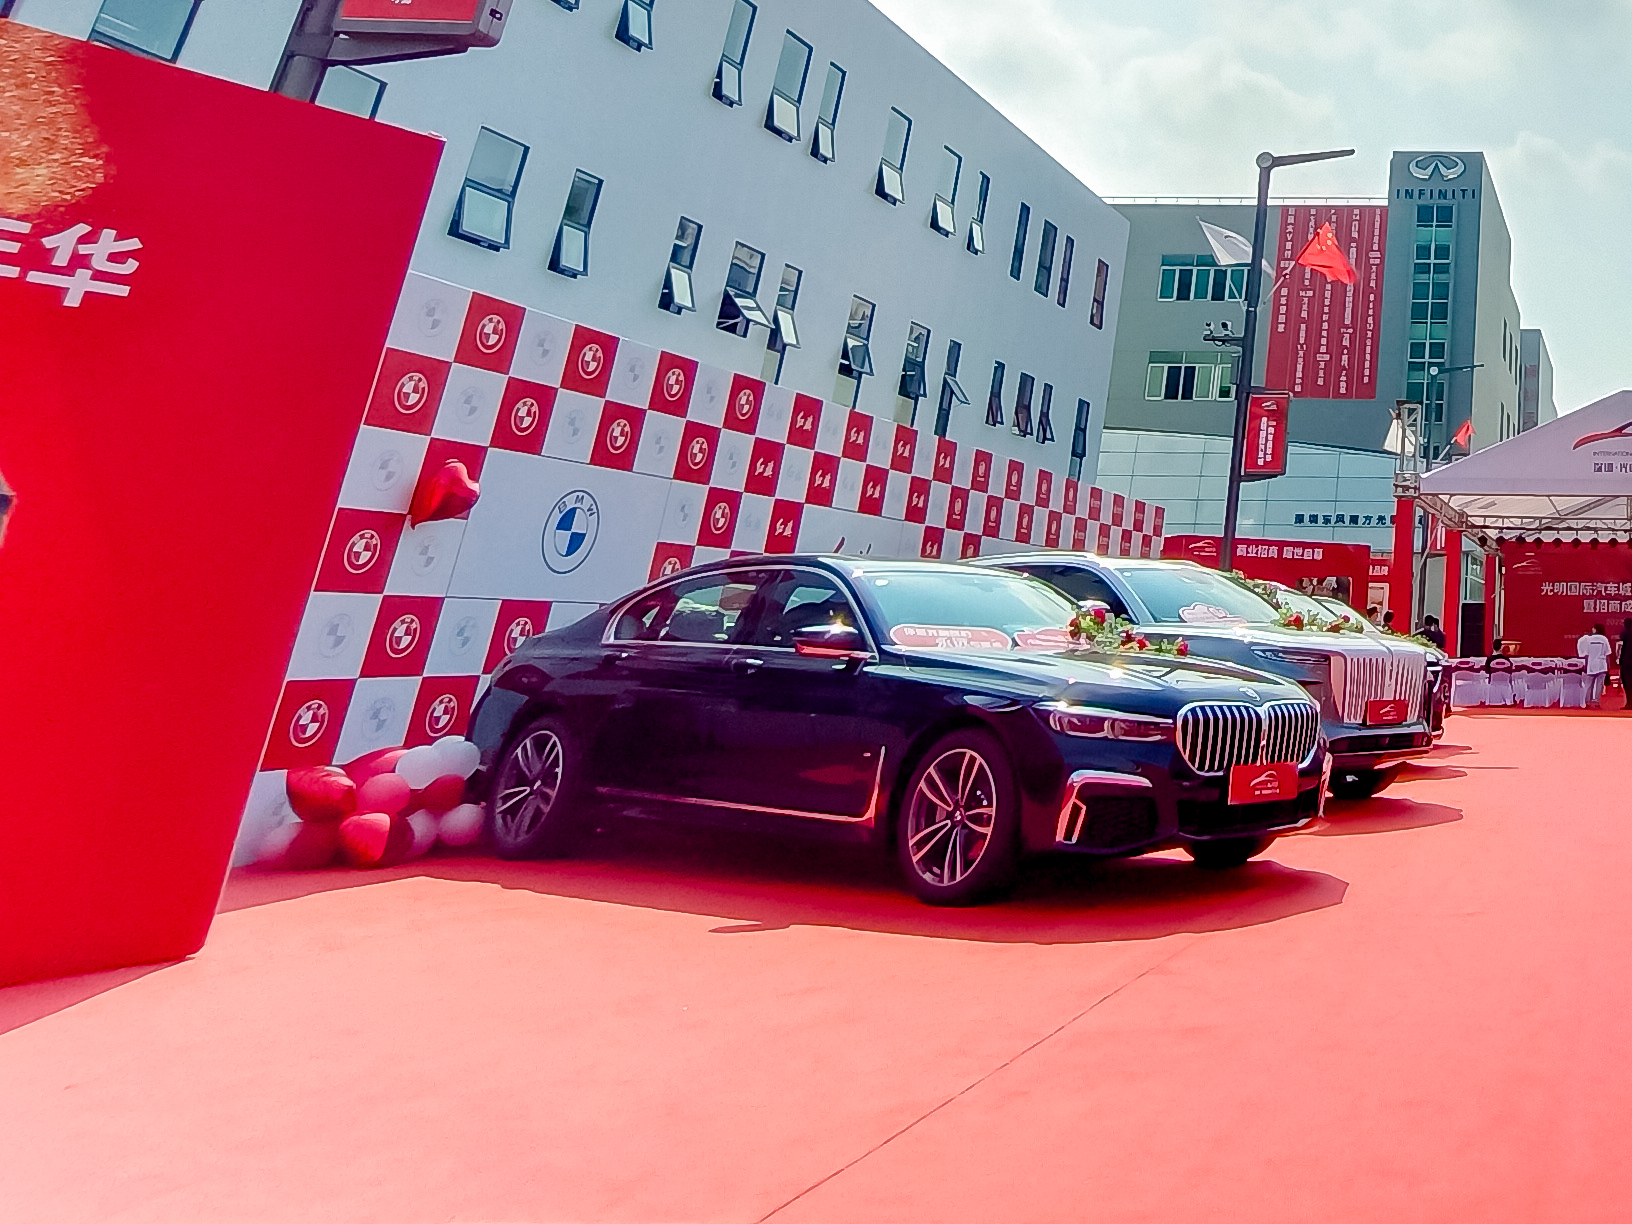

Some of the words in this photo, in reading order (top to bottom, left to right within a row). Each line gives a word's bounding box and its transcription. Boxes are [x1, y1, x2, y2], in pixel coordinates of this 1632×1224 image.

[1396, 188, 1476, 200] INFINITI
[557, 494, 598, 518] BMW
[1294, 513, 1396, 525] 深圳东风南方光
